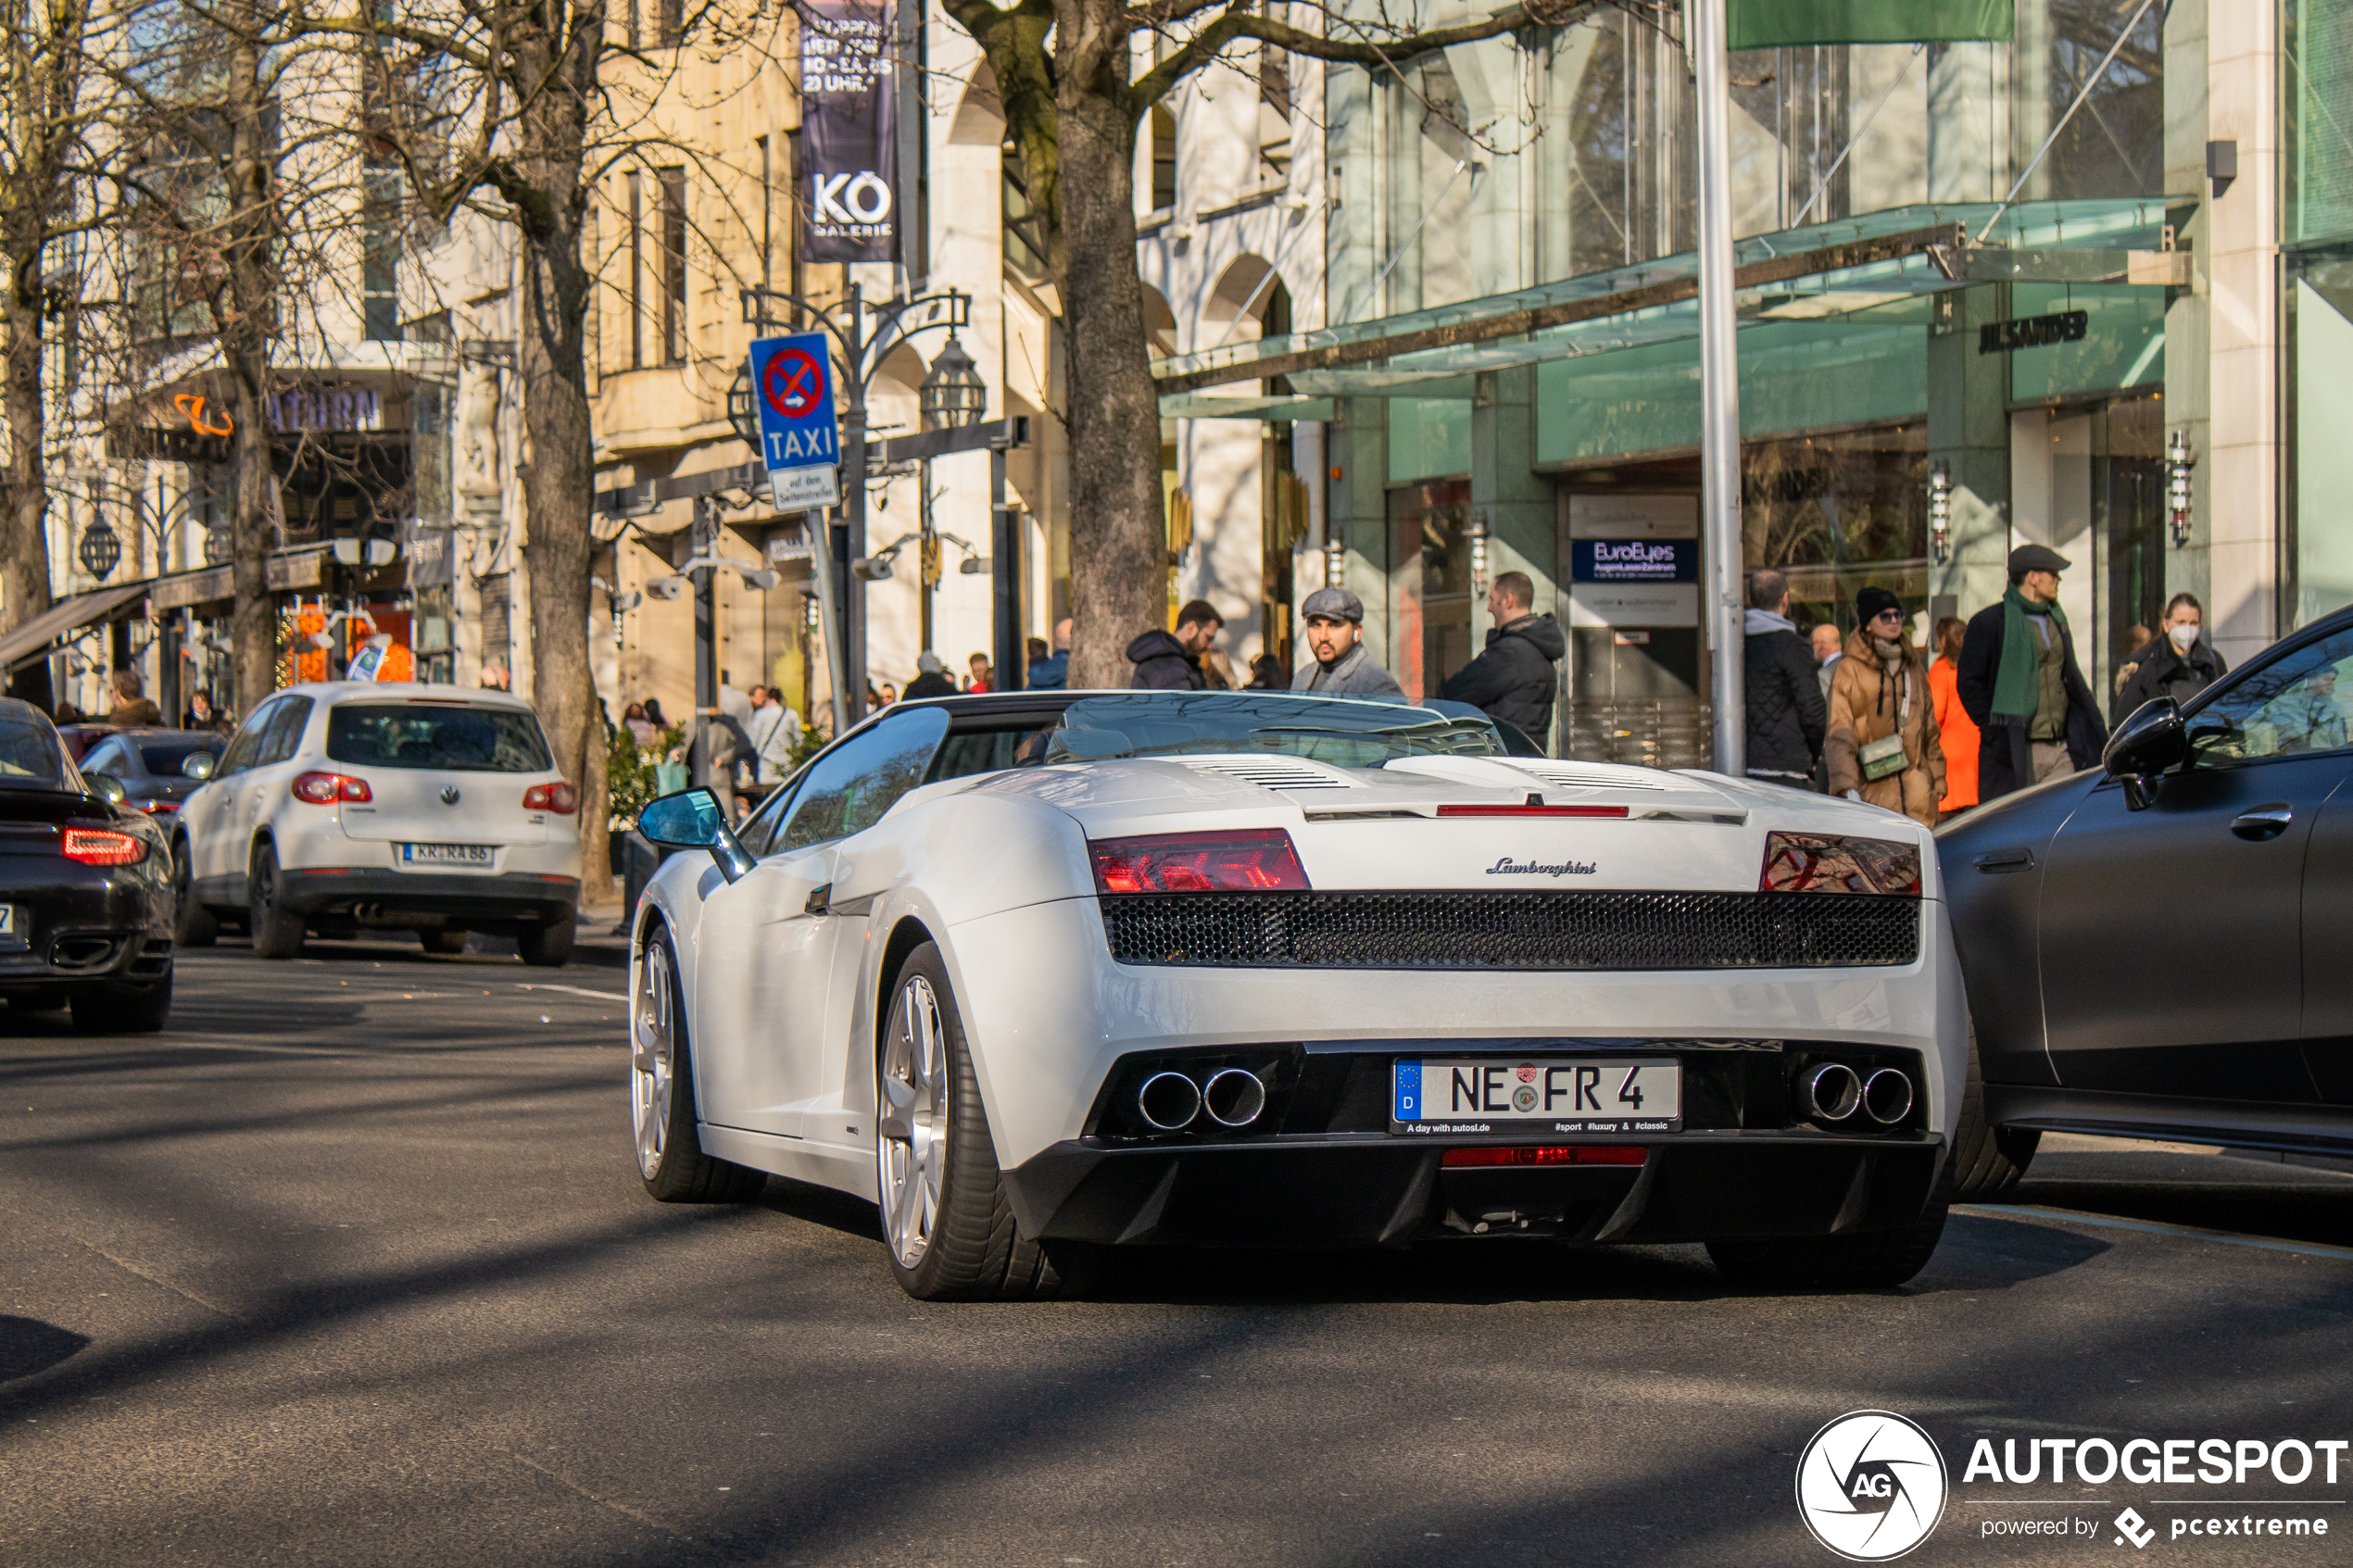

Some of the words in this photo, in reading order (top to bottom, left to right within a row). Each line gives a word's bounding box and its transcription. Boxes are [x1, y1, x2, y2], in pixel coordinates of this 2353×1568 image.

[813, 223, 893, 237] GALERIE
[769, 427, 832, 460] TAXI
[789, 477, 802, 487] auf
[805, 475, 822, 485] dem
[779, 488, 833, 503] Seitenstreifen
[1594, 542, 1674, 563] EuroEyes
[418, 844, 437, 859] KR
[447, 845, 466, 859] RA
[1485, 857, 1596, 877] Lamborghini
[1451, 1067, 1510, 1111] NE
[1544, 1066, 1602, 1111] FR
[1617, 1066, 1643, 1110] 4
[1403, 1097, 1414, 1110] D
[1416, 1124, 1431, 1134] day
[1452, 1123, 1491, 1132] autosl.de
[1555, 1123, 1582, 1132] #sport
[1588, 1123, 1617, 1132] #luxury
[1622, 1122, 1629, 1130] &
[1635, 1122, 1667, 1130] #classic
